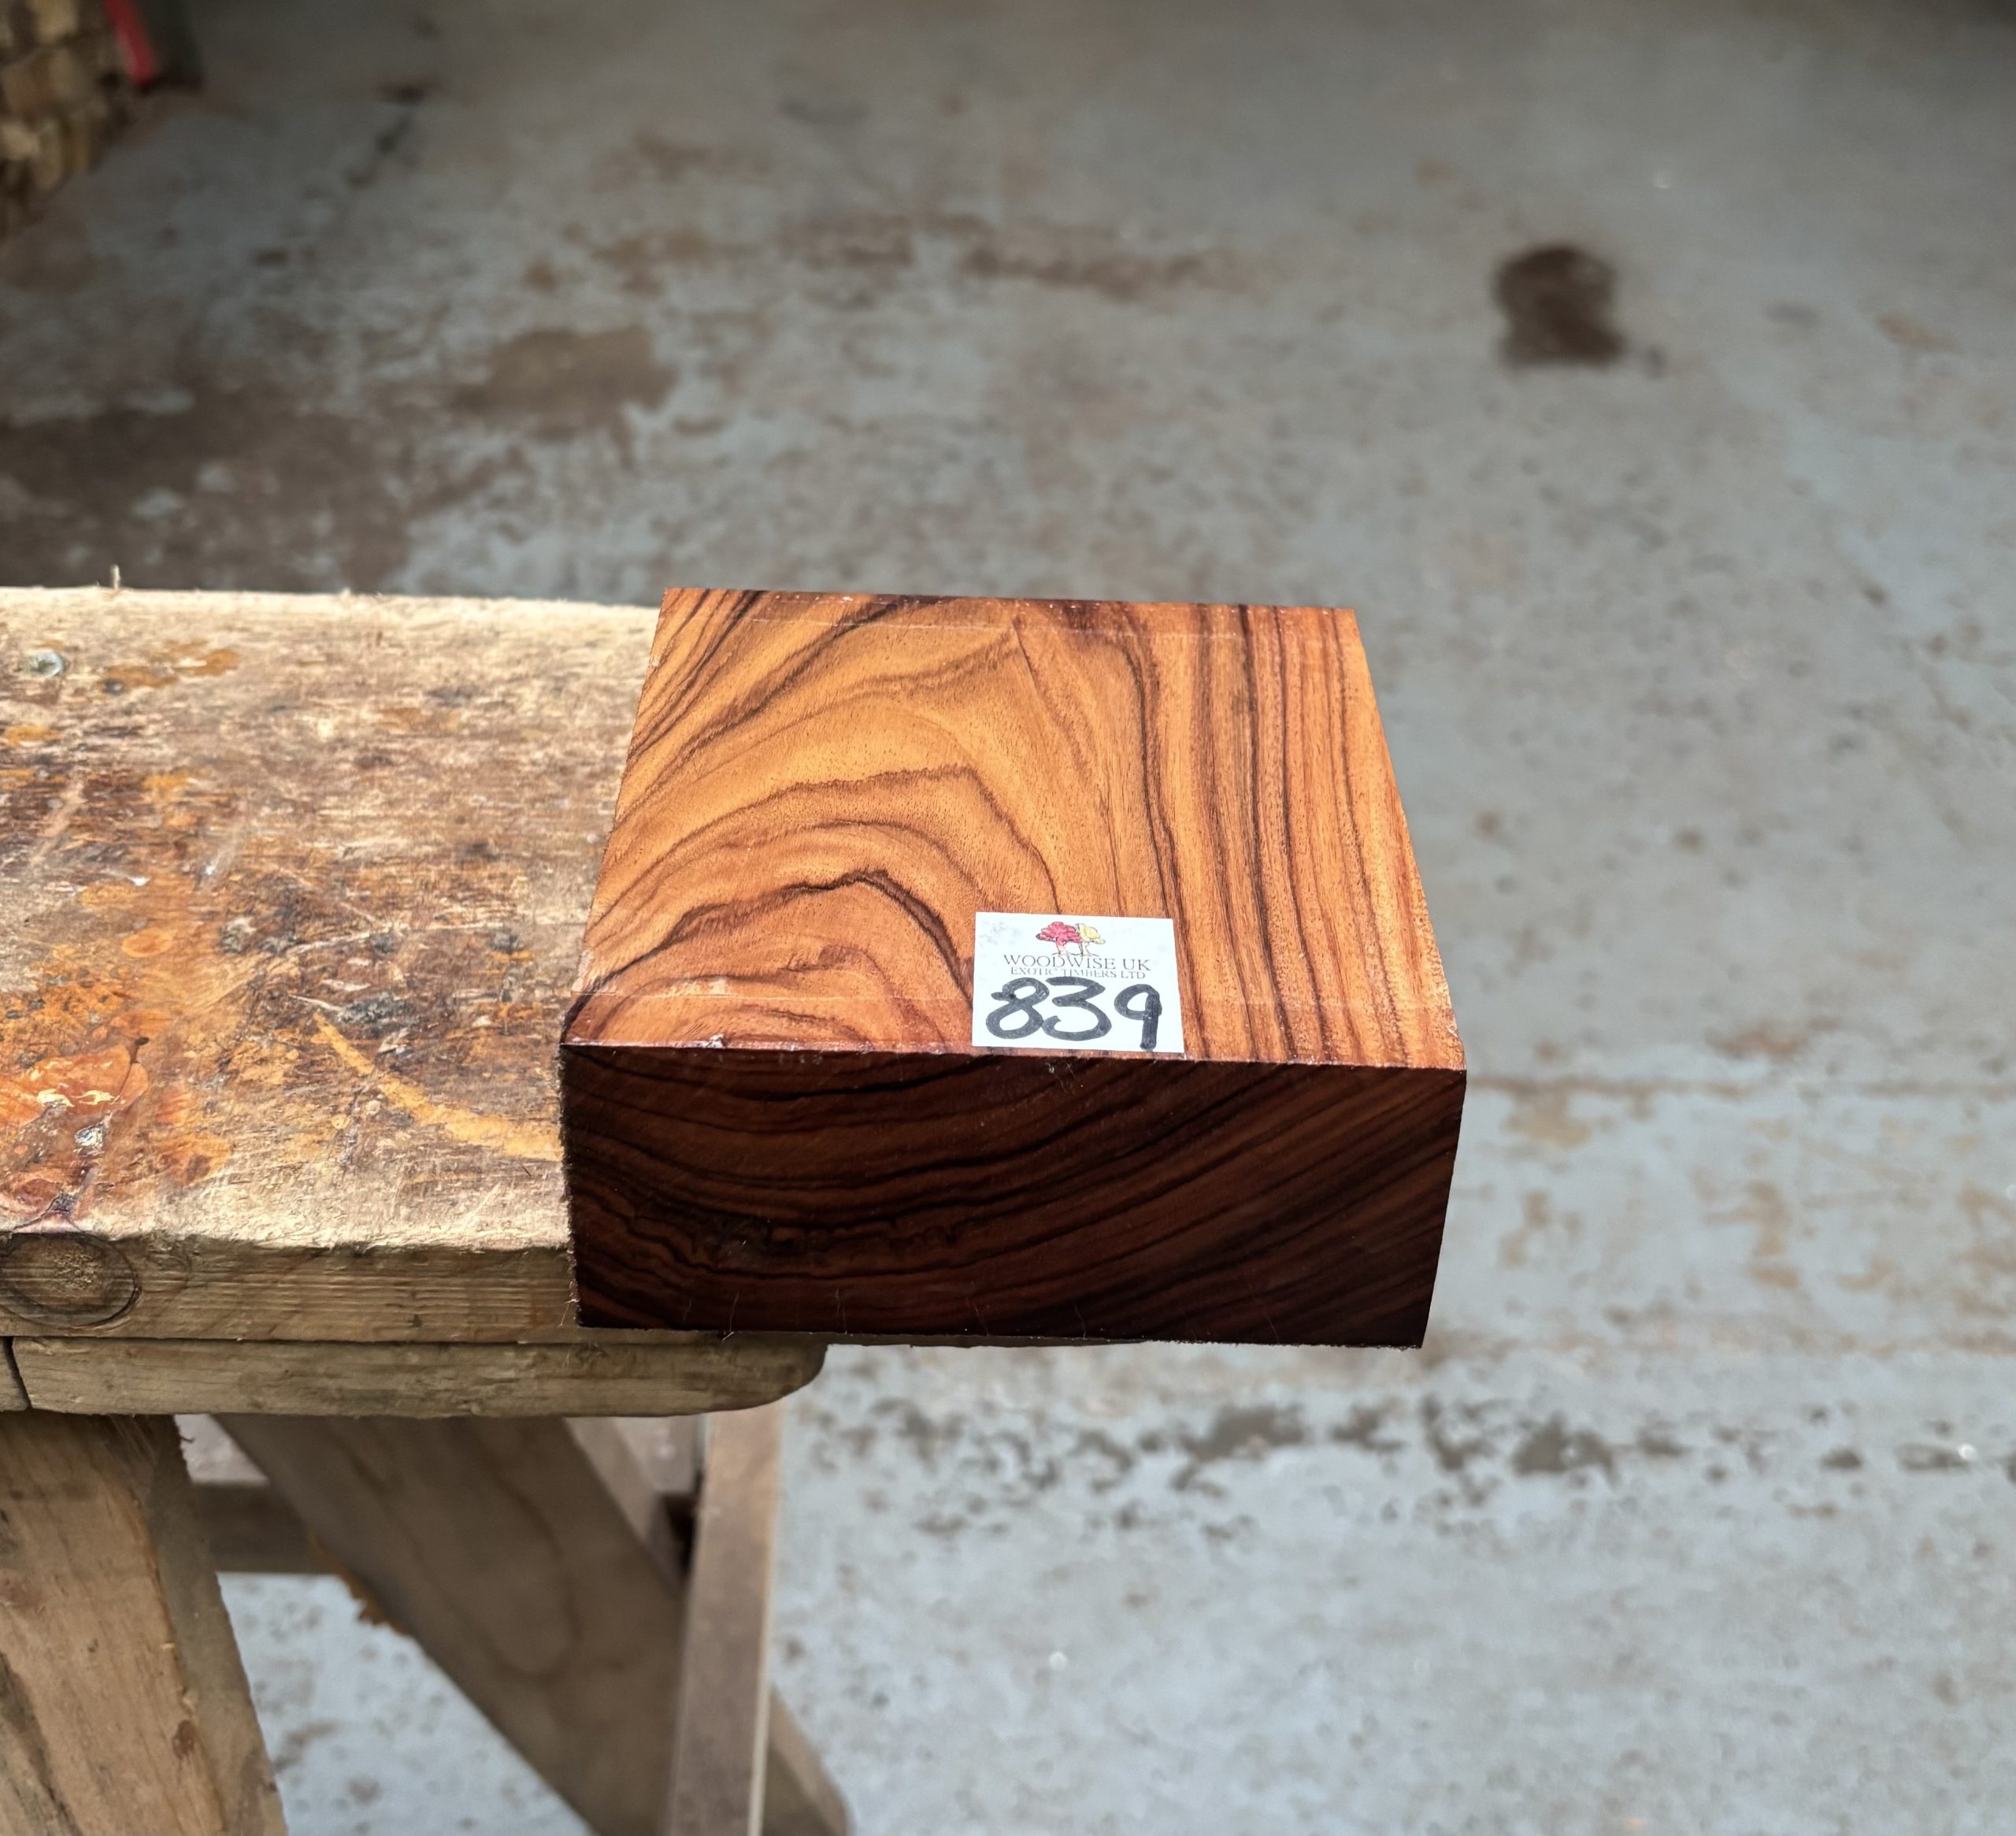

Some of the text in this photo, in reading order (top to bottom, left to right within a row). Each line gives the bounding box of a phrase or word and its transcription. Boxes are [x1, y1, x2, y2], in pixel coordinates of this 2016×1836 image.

[1003, 954, 1151, 971] WOODWISE UK
[985, 977, 1162, 1051] 839
